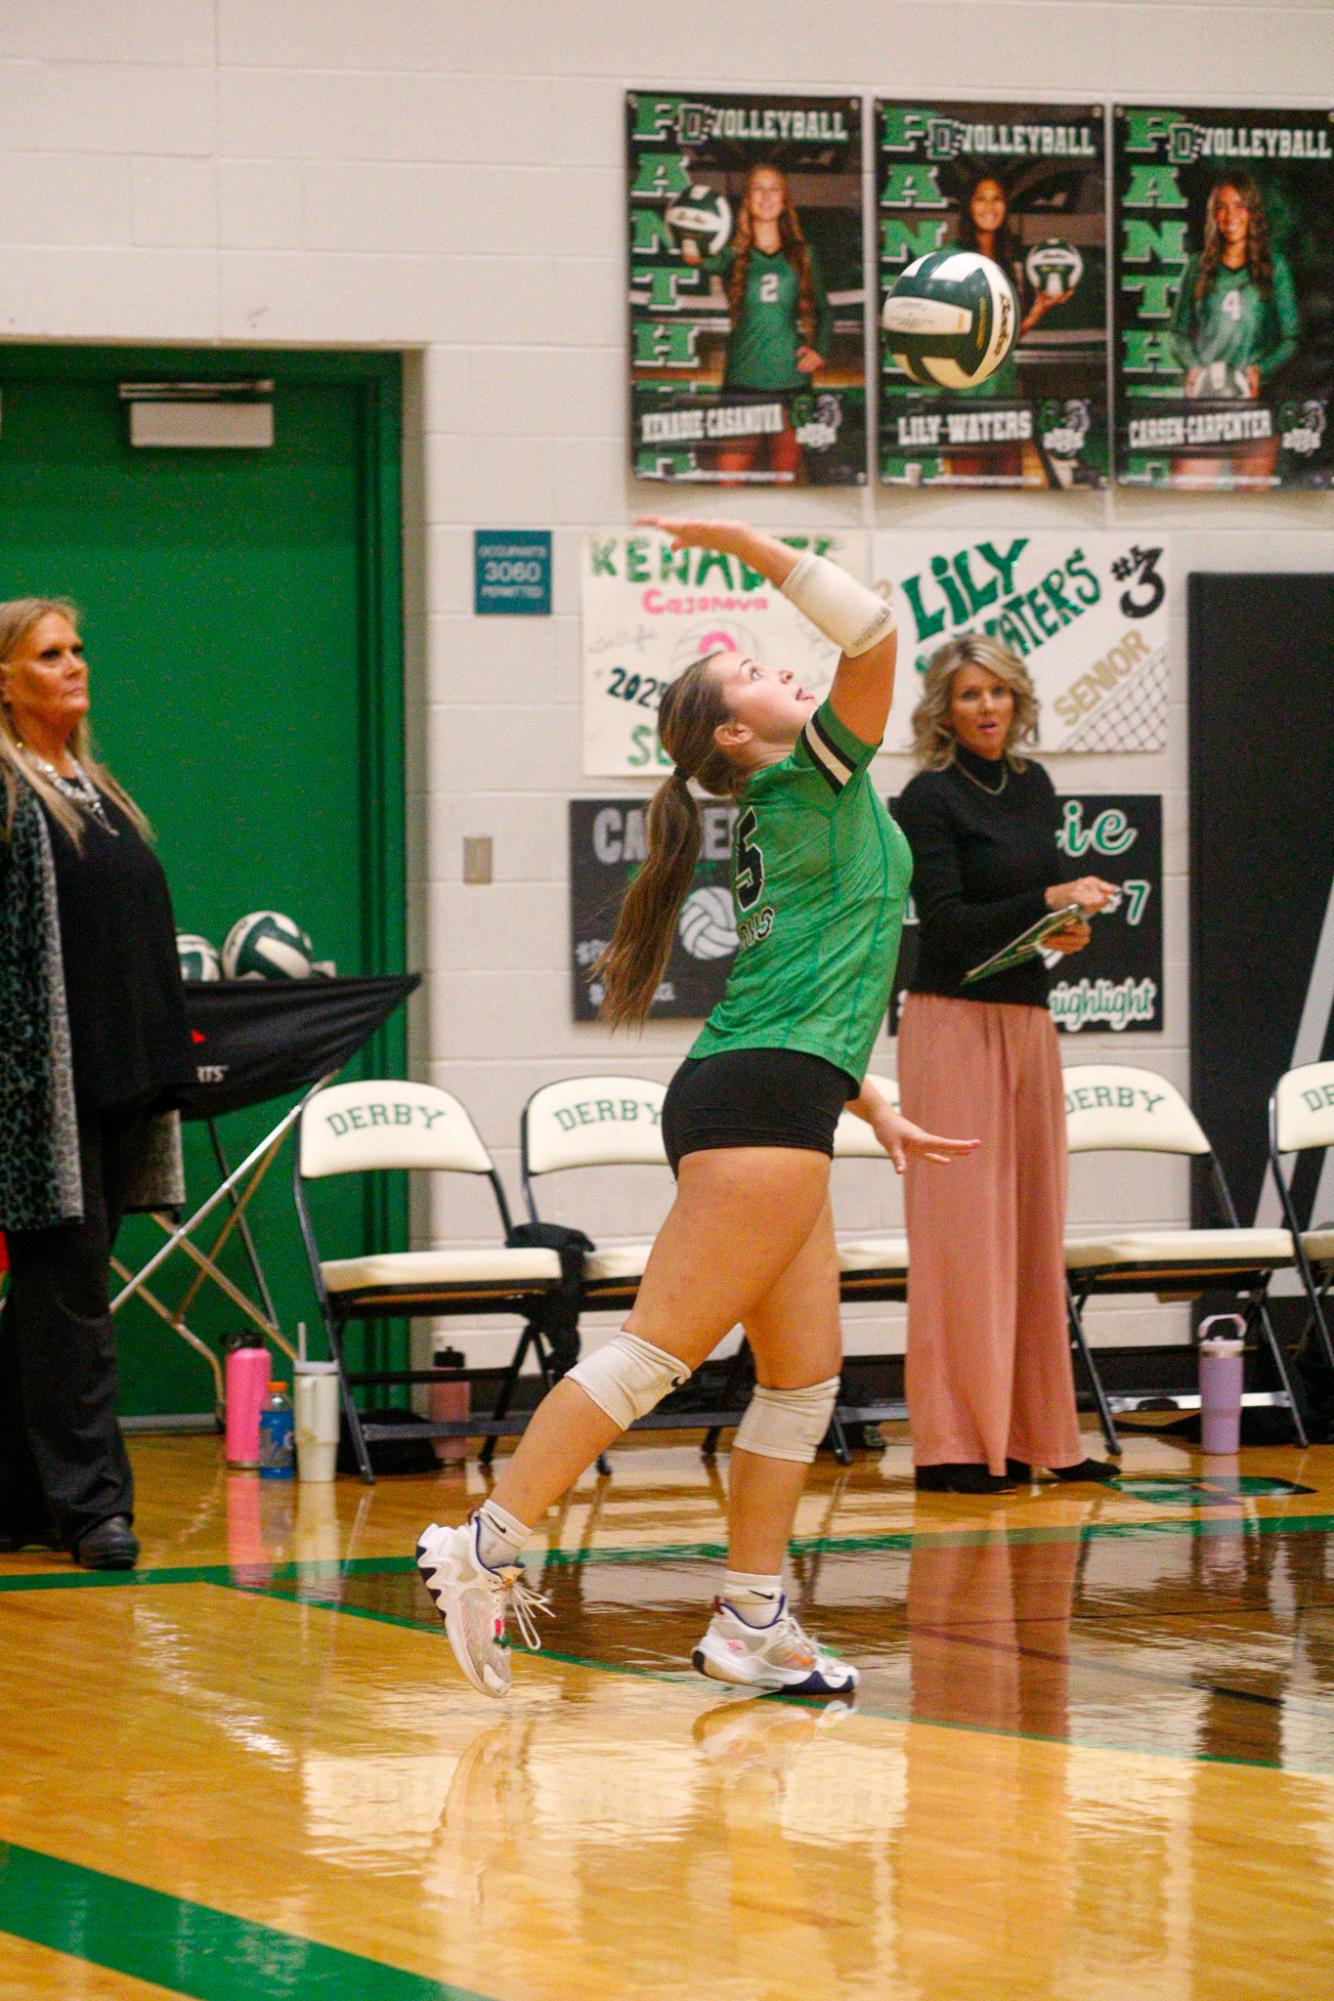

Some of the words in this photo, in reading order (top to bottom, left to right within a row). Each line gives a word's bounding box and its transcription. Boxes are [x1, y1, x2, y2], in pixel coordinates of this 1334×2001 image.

[712, 108, 848, 141] VOLLEYBALL
[961, 124, 1096, 155] VOLLEYBALL
[1201, 128, 1333, 159] VOLLEYBALL
[760, 273, 779, 303] 2
[1222, 289, 1242, 322] 4
[946, 410, 1034, 444] WATERS
[484, 560, 542, 583] 3060
[1111, 545, 1166, 619] #3
[953, 547, 1102, 658] ATERS
[1053, 628, 1152, 728] SENIOR
[325, 1103, 447, 1138] DERBY
[553, 1099, 662, 1132] DERBY
